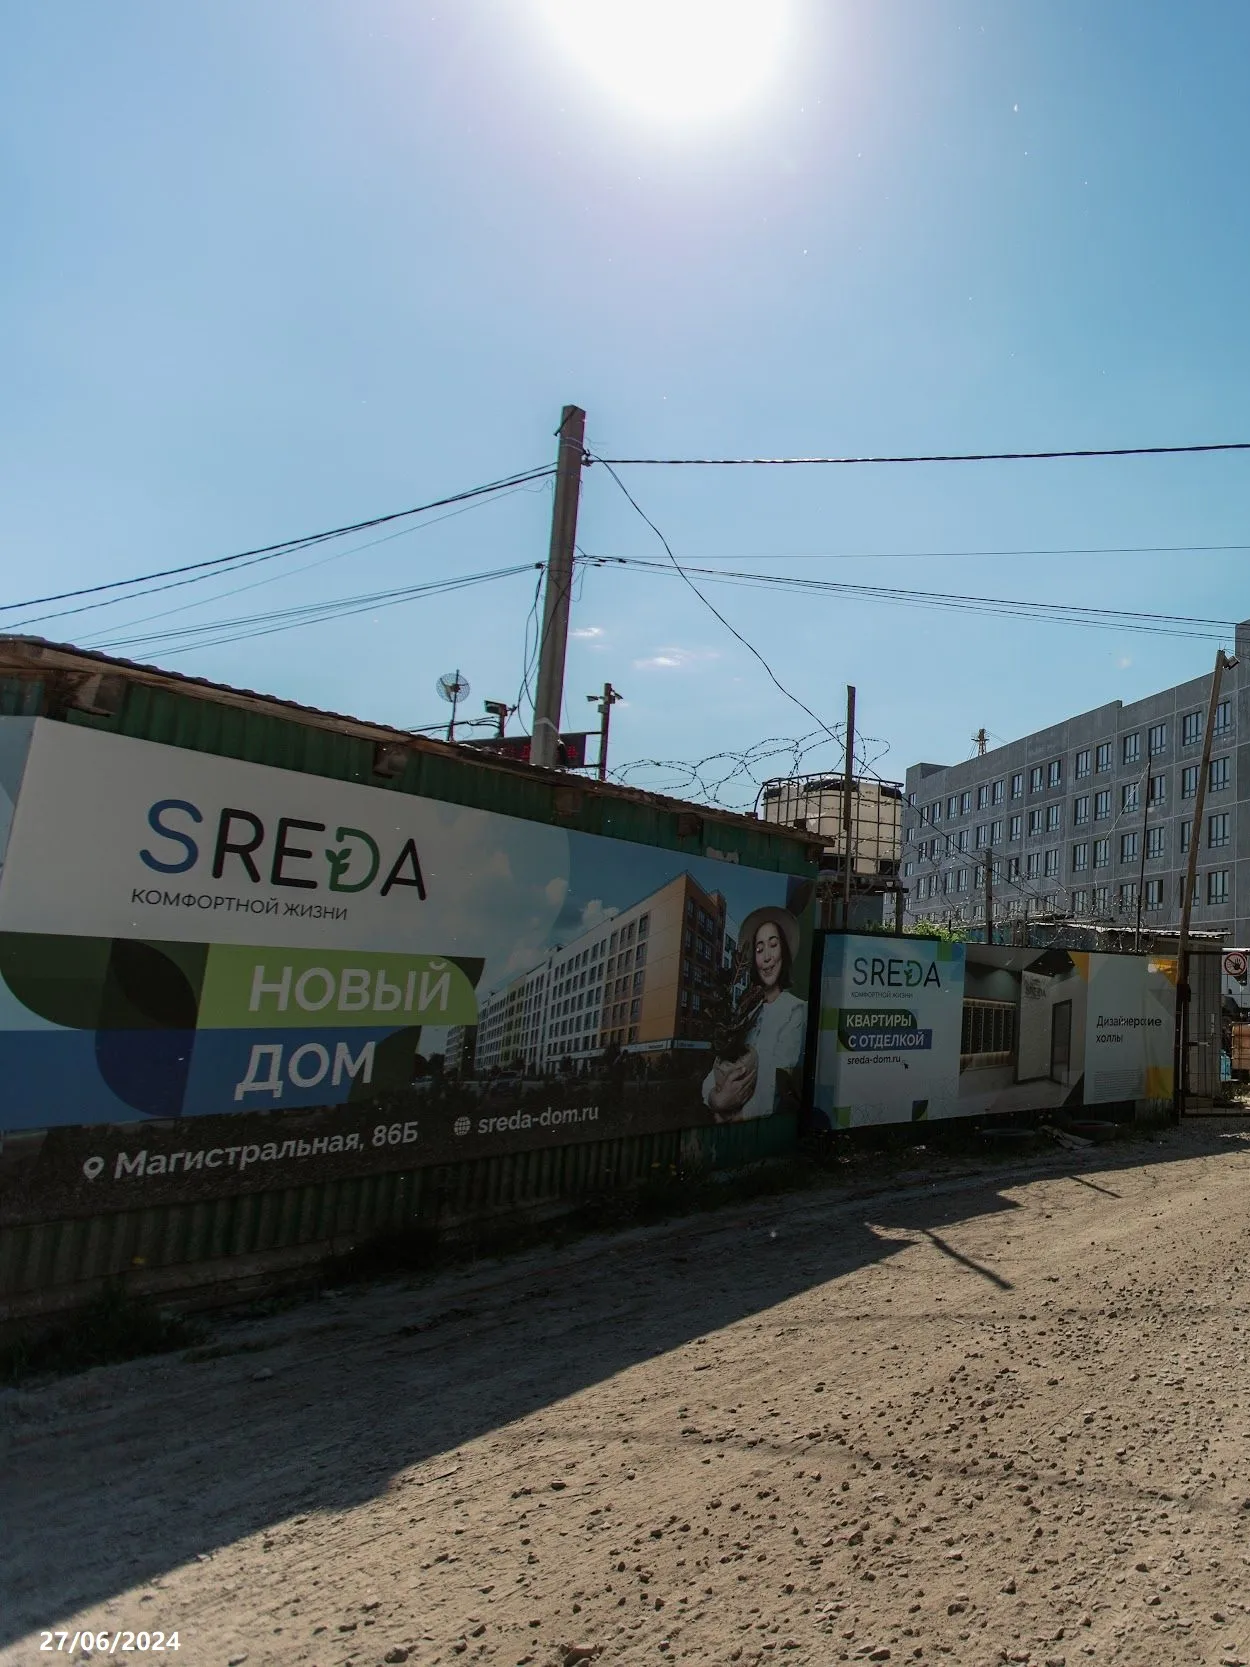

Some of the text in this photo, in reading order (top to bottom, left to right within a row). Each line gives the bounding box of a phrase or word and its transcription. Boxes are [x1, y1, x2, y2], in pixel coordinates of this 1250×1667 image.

[139, 799, 426, 901] SREDA
[131, 888, 348, 921] КОМФОРТНОЙ ЖИЗНИ
[248, 961, 451, 1012] НОВЫЙ
[852, 957, 941, 988] SREDA
[846, 1014, 912, 1027] КВАРТИРЫ
[848, 1031, 925, 1049] С ОТДЕЛКОЙ
[1095, 1034, 1124, 1043] холлы
[233, 1041, 376, 1101] ДОМ
[847, 1054, 901, 1065] sreda-dom.ru
[477, 1106, 599, 1135] sreda-dom.ru
[114, 1121, 418, 1179] Магистральная, 86Б
